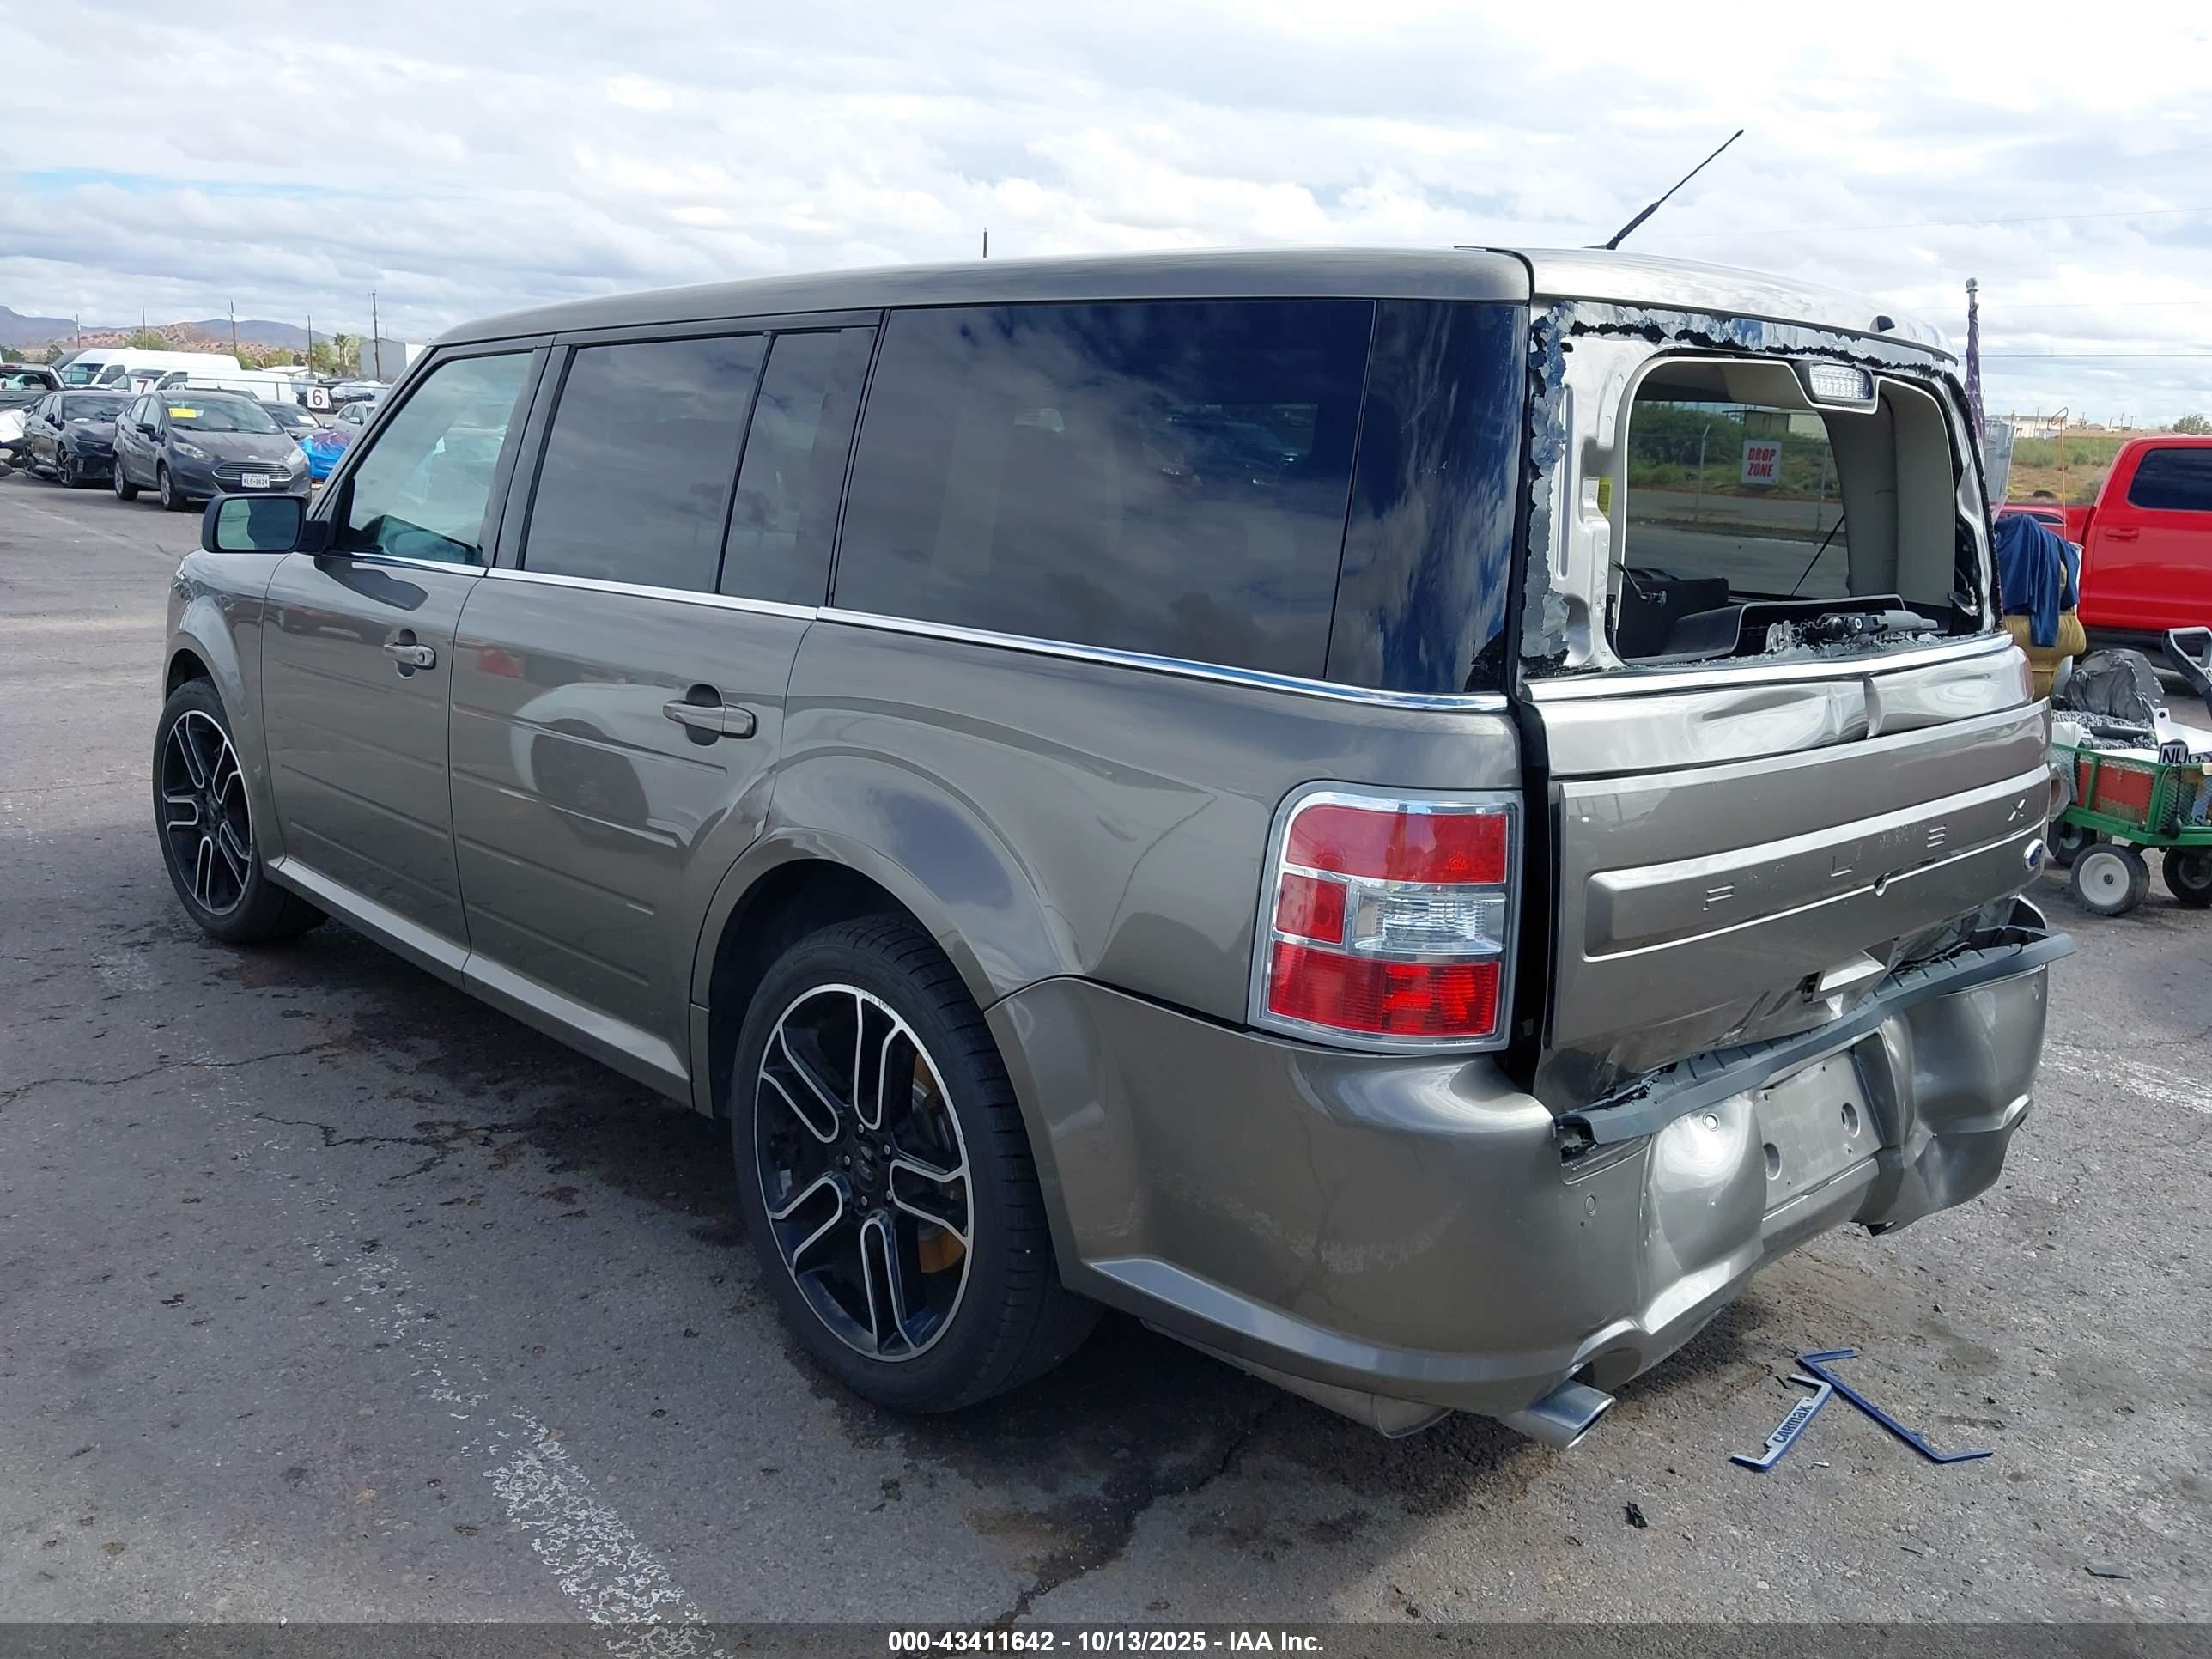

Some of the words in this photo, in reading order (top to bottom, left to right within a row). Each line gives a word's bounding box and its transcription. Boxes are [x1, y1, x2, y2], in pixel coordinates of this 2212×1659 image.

[136, 380, 149, 394] 7
[312, 388, 323, 406] 6
[1747, 447, 1777, 461] DROP
[1747, 463, 1773, 477] ZONE
[1703, 798, 2027, 912] FLEX
